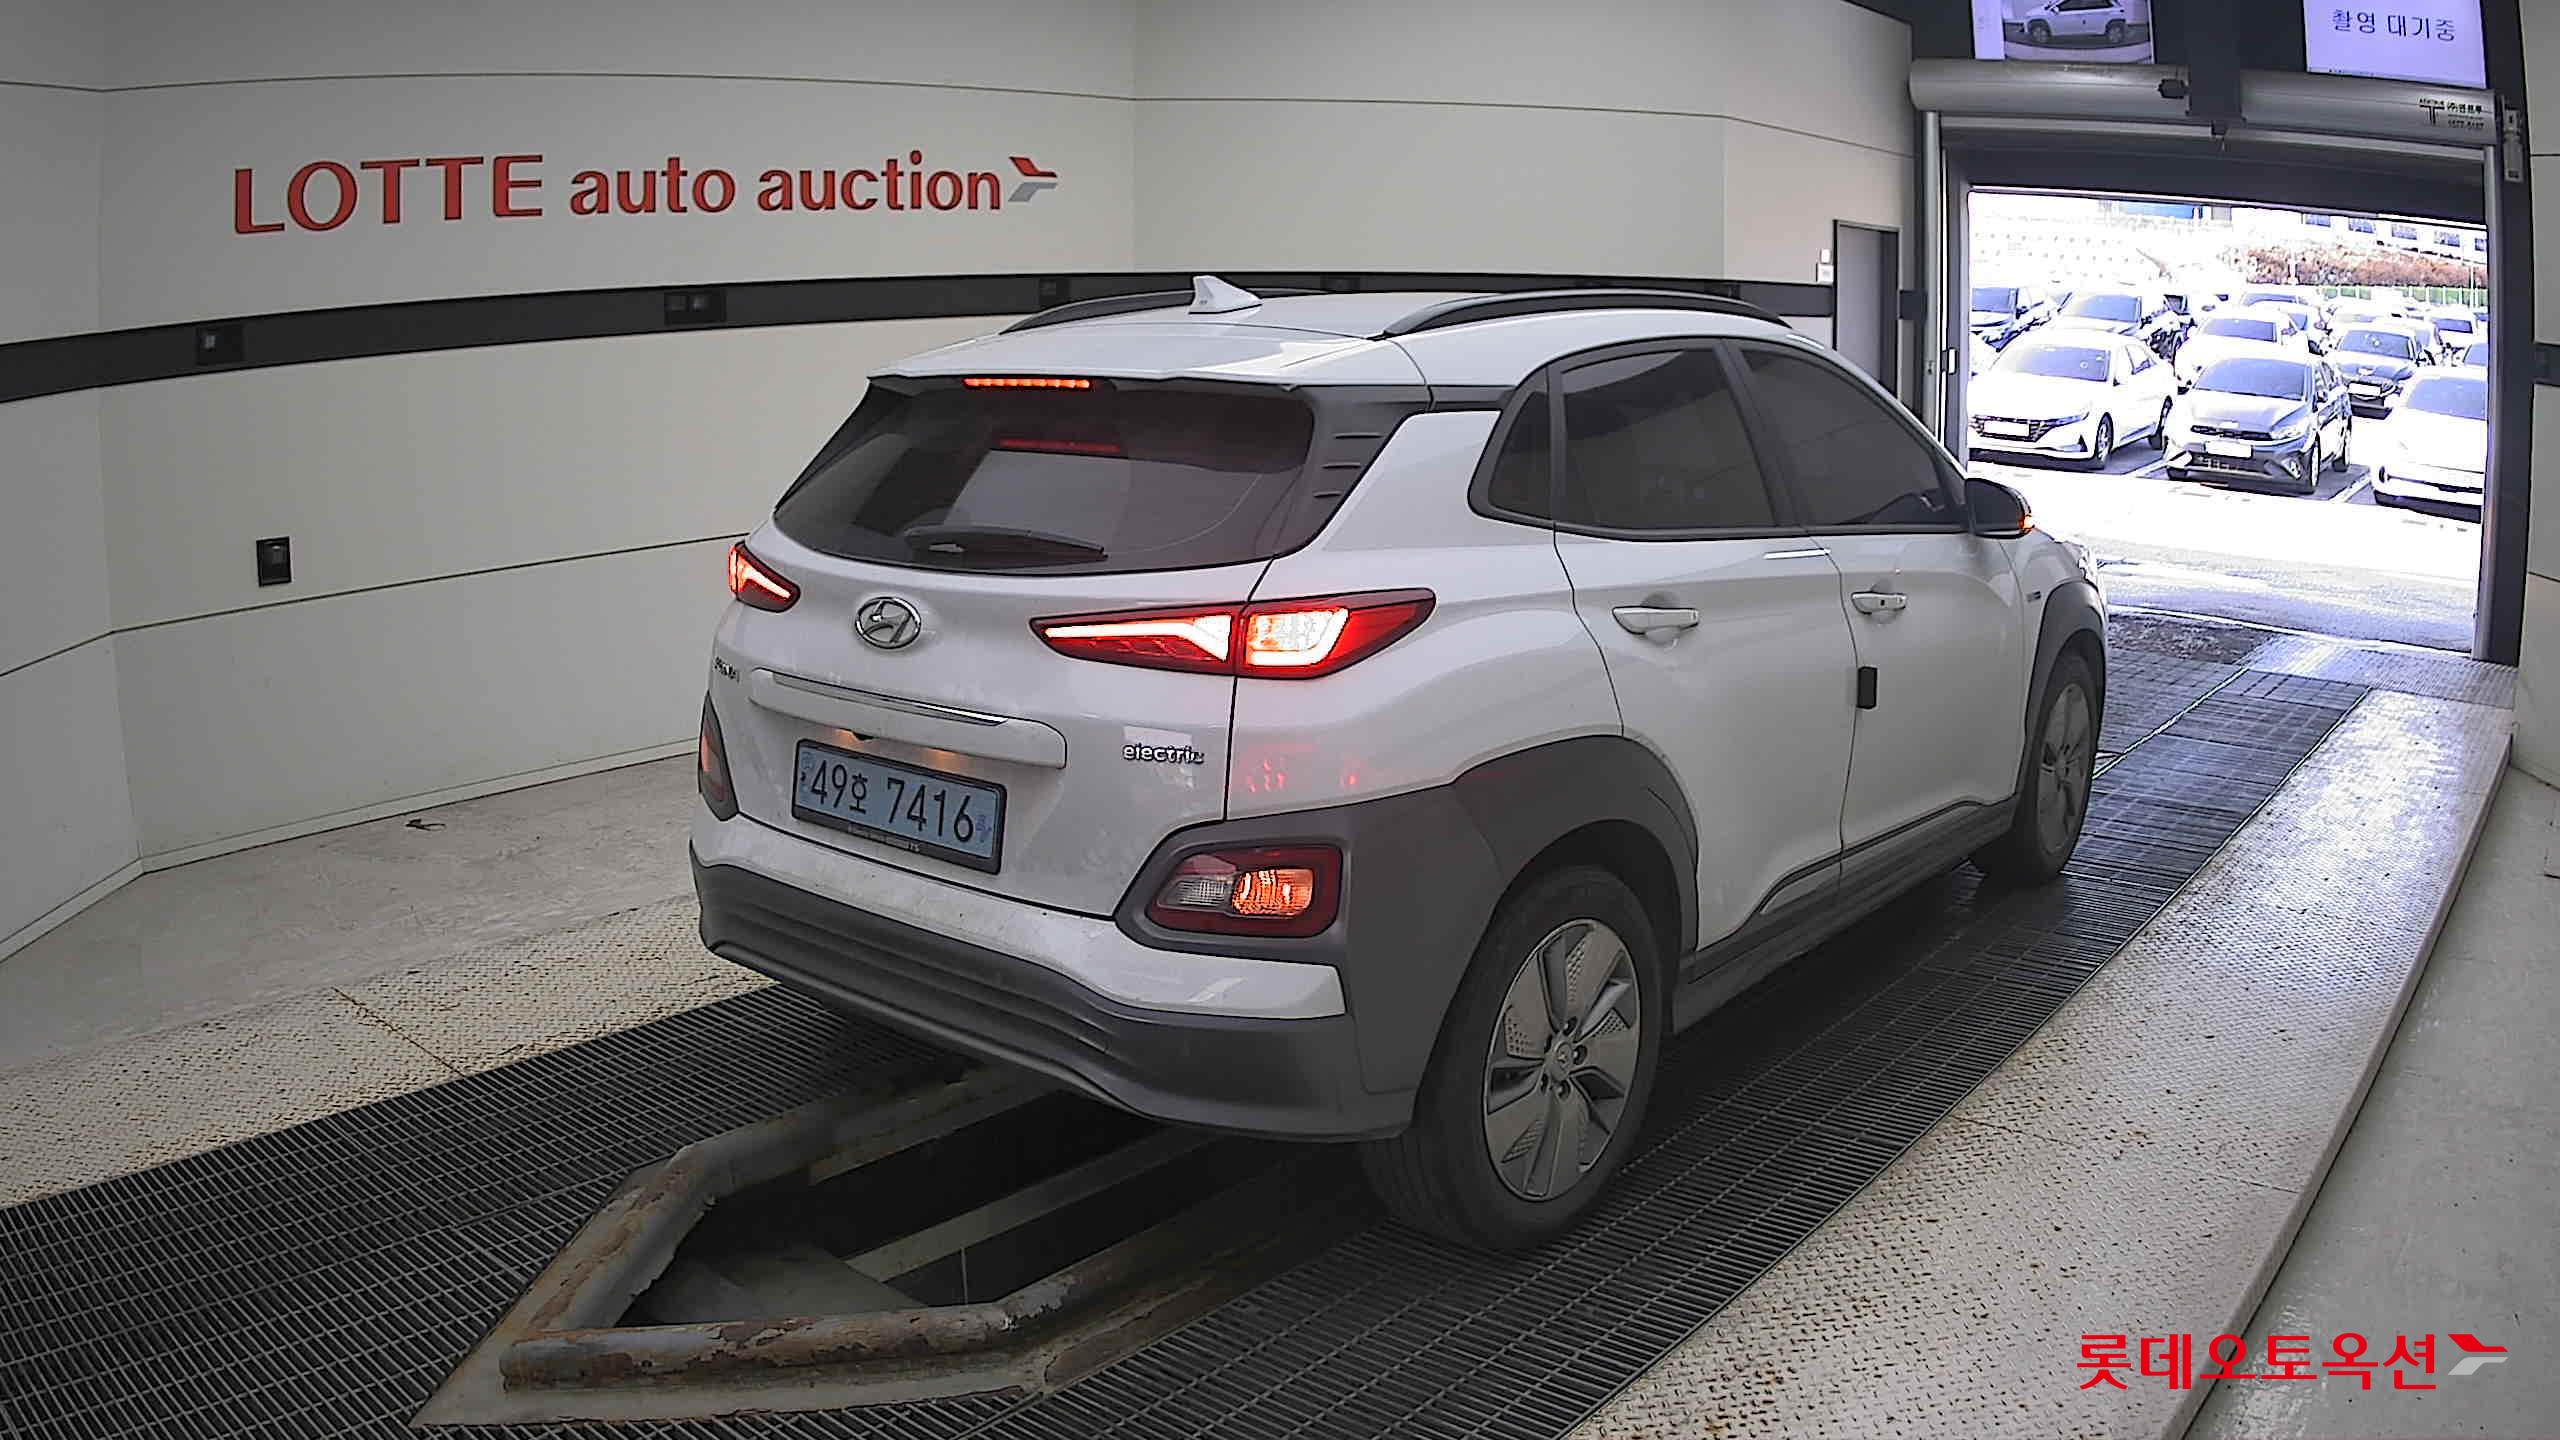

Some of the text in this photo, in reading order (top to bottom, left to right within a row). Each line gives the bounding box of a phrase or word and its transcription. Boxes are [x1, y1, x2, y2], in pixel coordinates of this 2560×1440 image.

[2332, 9, 2455, 42] 촬영 대기중
[234, 149, 1001, 235] LOTTE auto auction
[1122, 742, 1205, 765] electric
[810, 760, 868, 814] 49호
[887, 776, 974, 842] 7416
